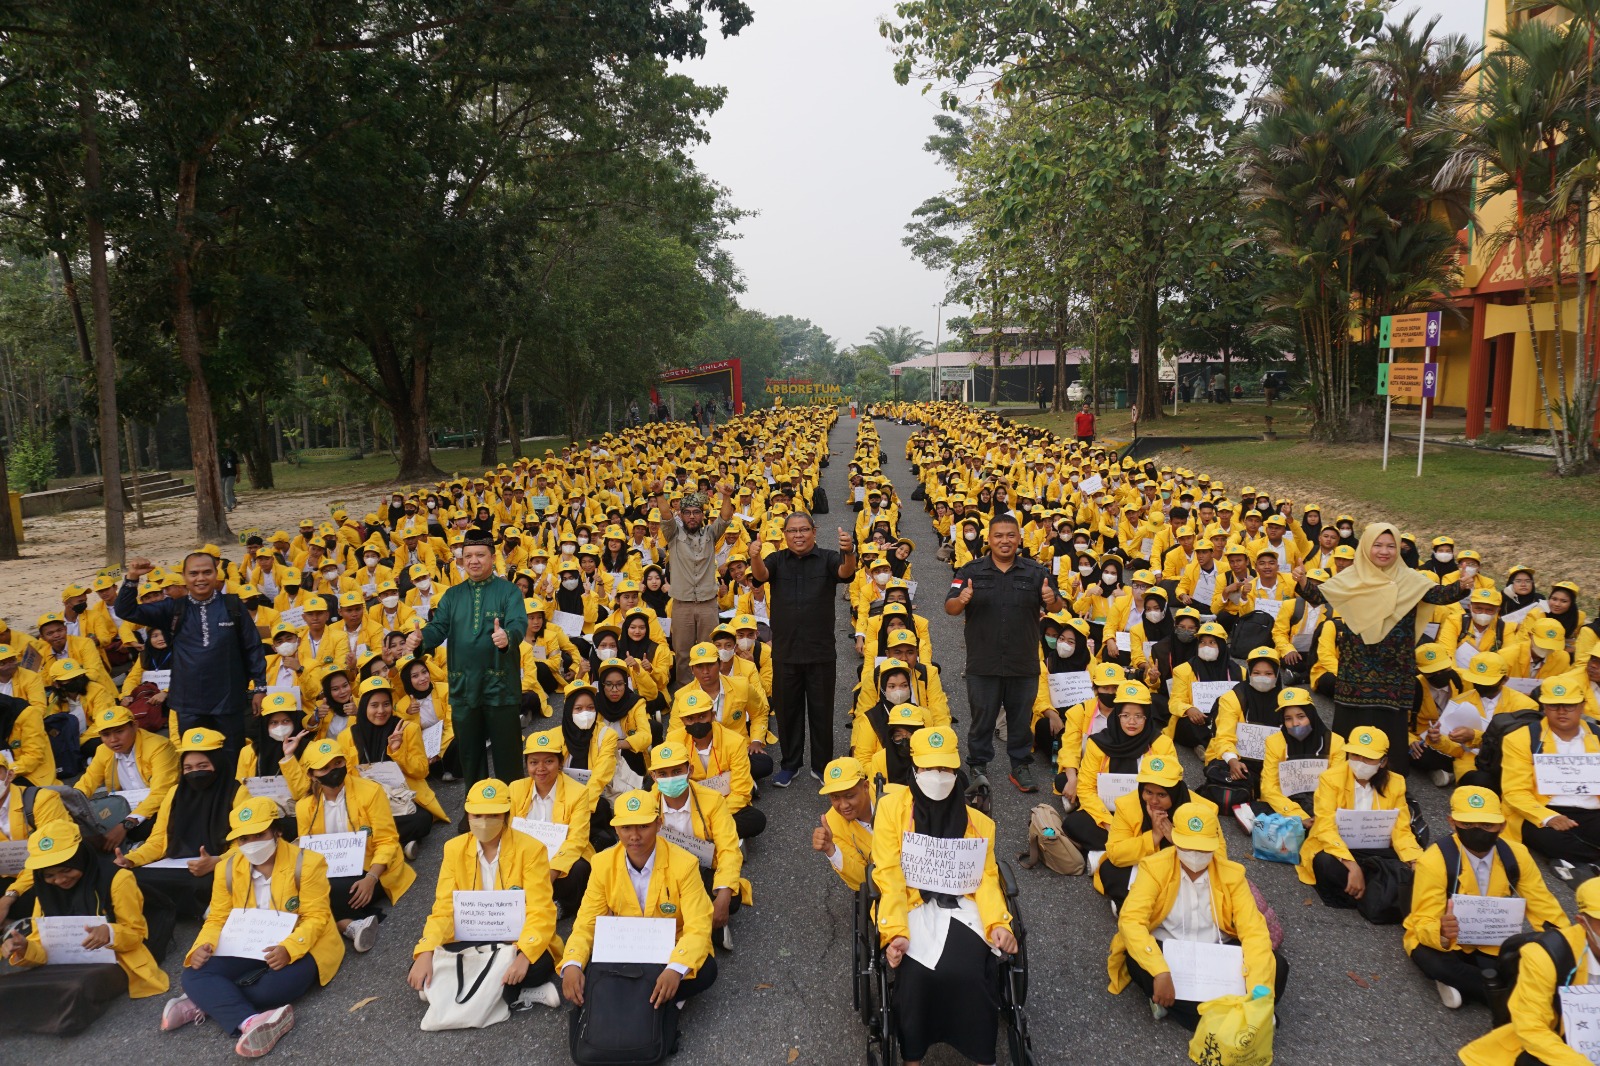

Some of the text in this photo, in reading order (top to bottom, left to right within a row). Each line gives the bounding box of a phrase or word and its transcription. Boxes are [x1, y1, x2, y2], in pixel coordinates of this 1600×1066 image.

[765, 384, 841, 394] ARBORETUM
[809, 395, 852, 404] UNILAK
[952, 839, 978, 851] FADILA
[901, 851, 976, 870] PERCAYA KAMU BISA
